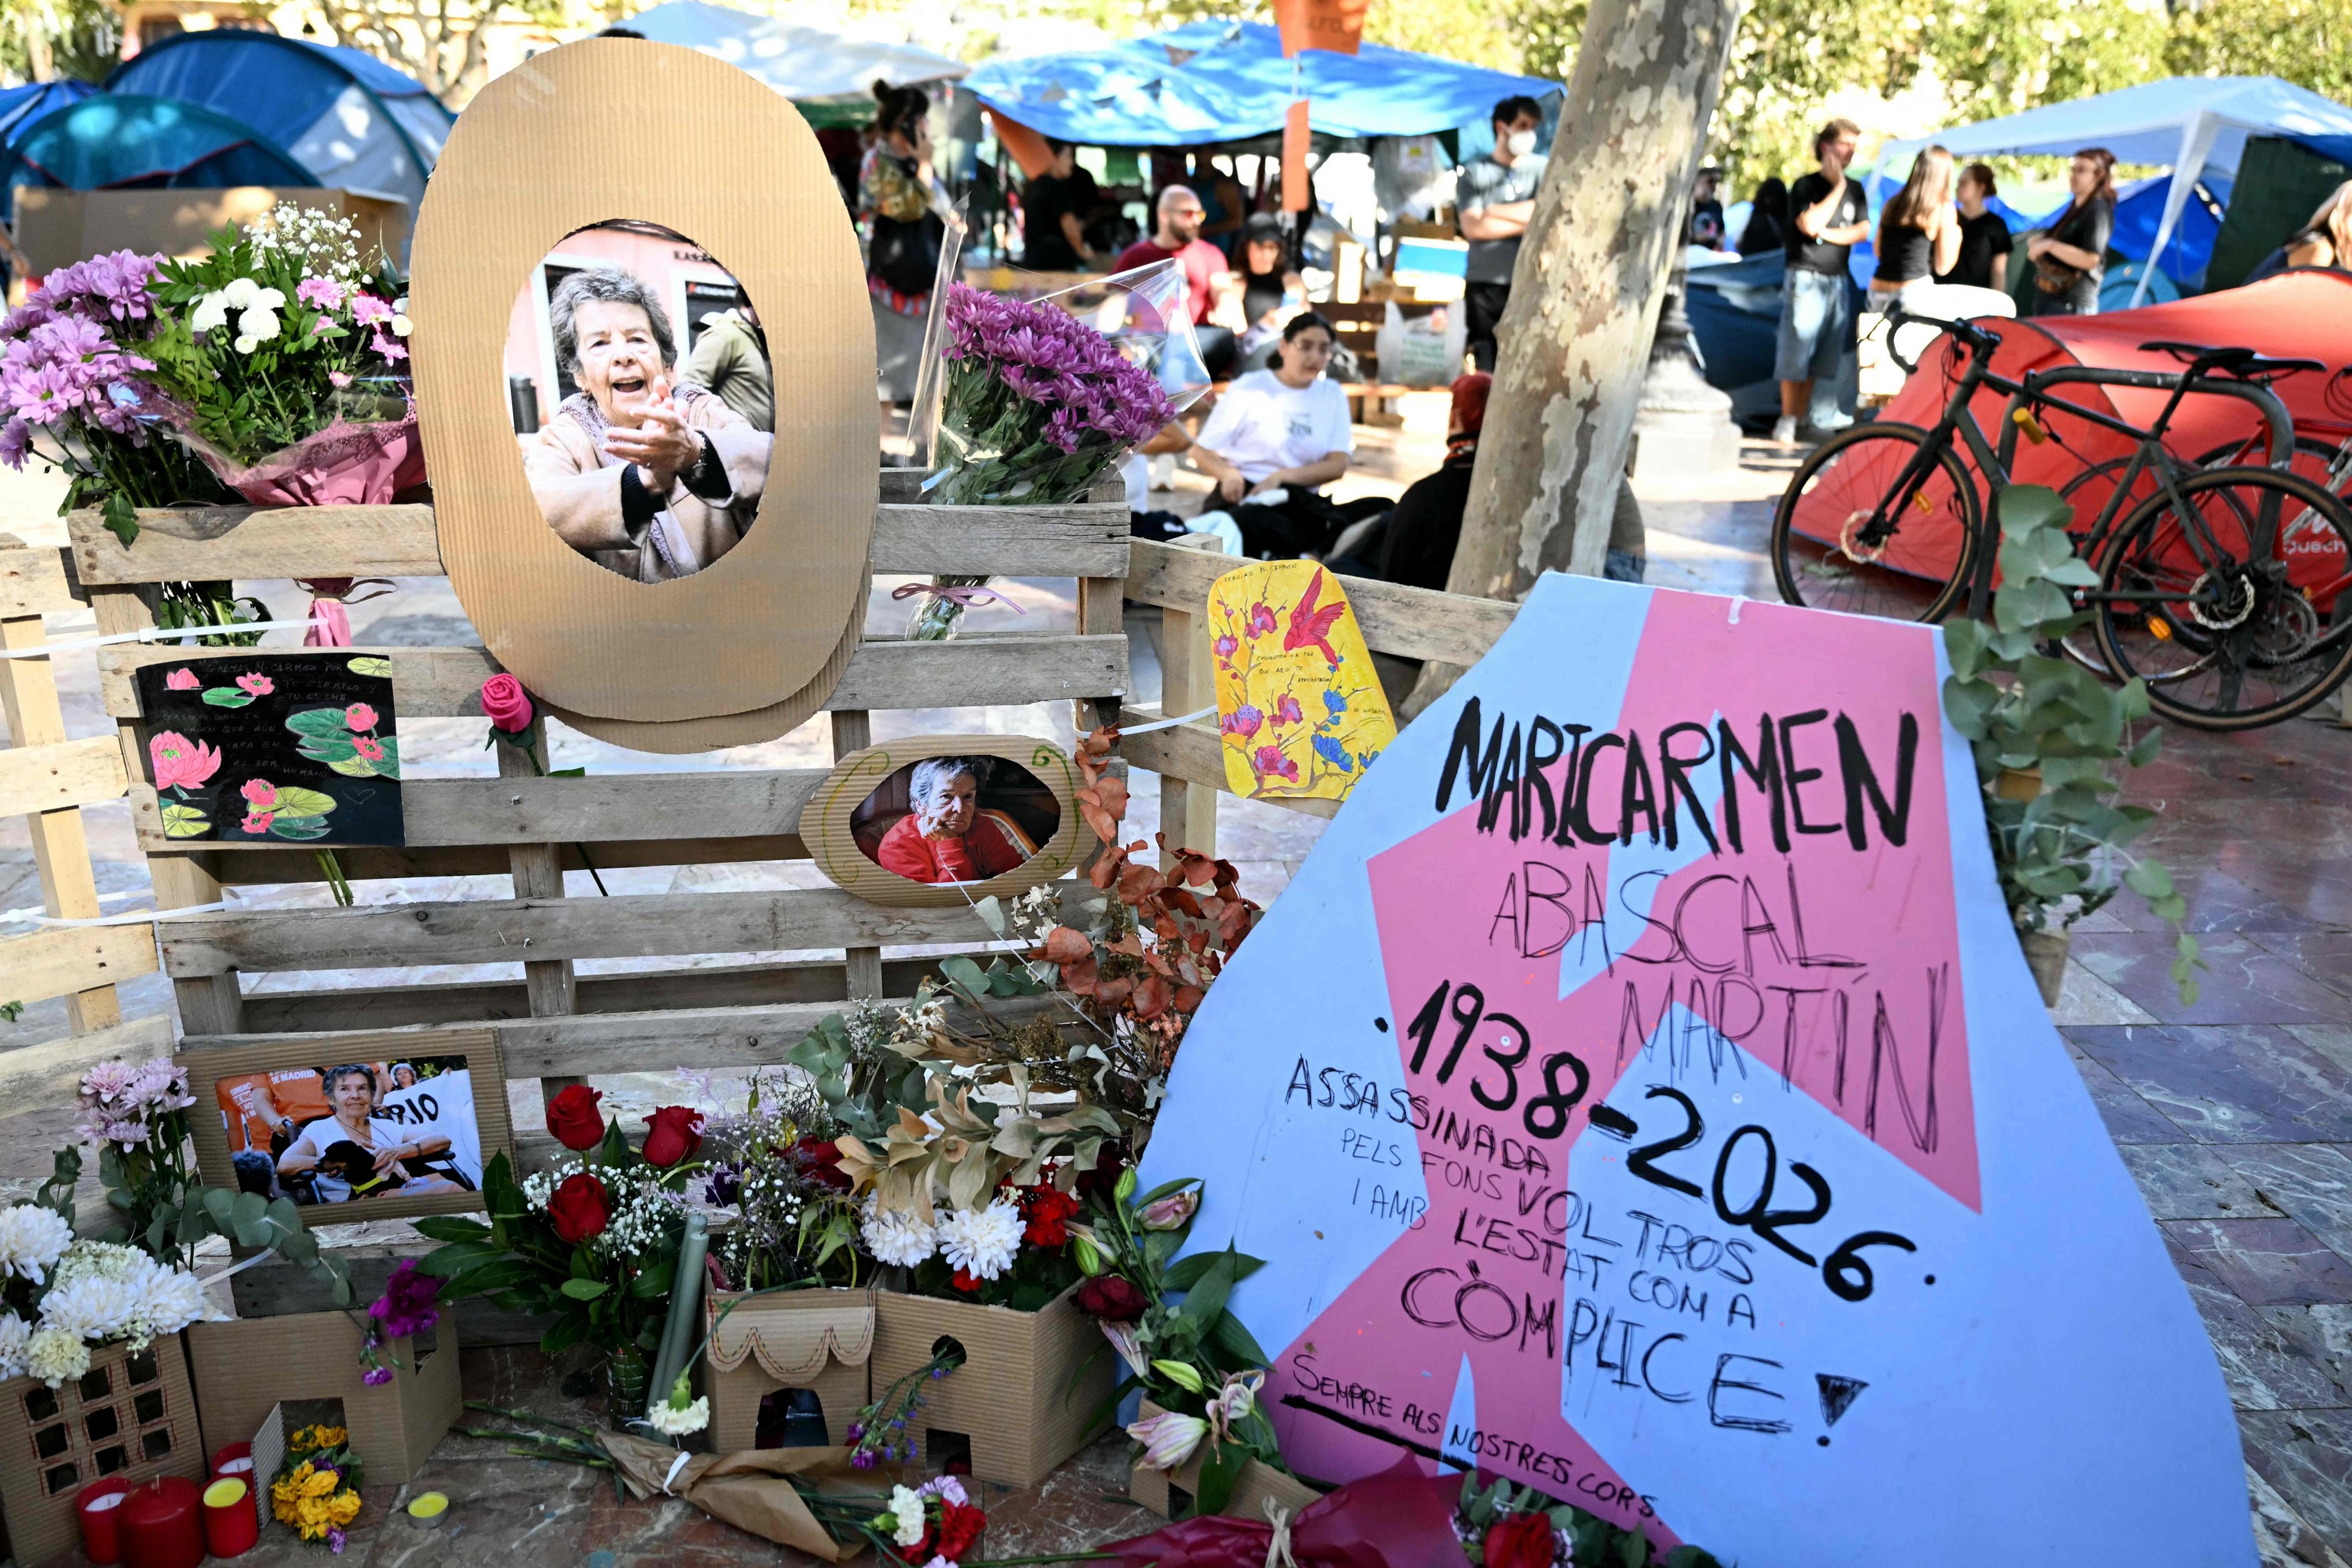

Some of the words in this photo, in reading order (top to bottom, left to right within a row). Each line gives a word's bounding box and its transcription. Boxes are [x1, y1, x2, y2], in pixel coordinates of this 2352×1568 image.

[1223, 570, 1254, 583] GRACIAS
[1269, 563, 1298, 572] CARMEN
[2283, 538, 2347, 556] Quech
[270, 662, 318, 672] CARMEN
[325, 663, 343, 672] POR
[221, 725, 245, 733] QUE
[1435, 695, 1919, 855] MARICARMEN
[1488, 860, 1867, 977] ABASCAL
[280, 1069, 316, 1082] MADRID
[1285, 1054, 1550, 1179] ASSASSINADA
[1341, 1127, 1403, 1167] PELS
[1420, 1151, 1502, 1200] FONS
[1370, 1184, 1426, 1230] AMB
[1727, 1292, 1756, 1330] A
[1292, 1354, 1393, 1419] SEMPRE
[1402, 1402, 1442, 1435] ALS
[1449, 1423, 1574, 1485] NOSTRES
